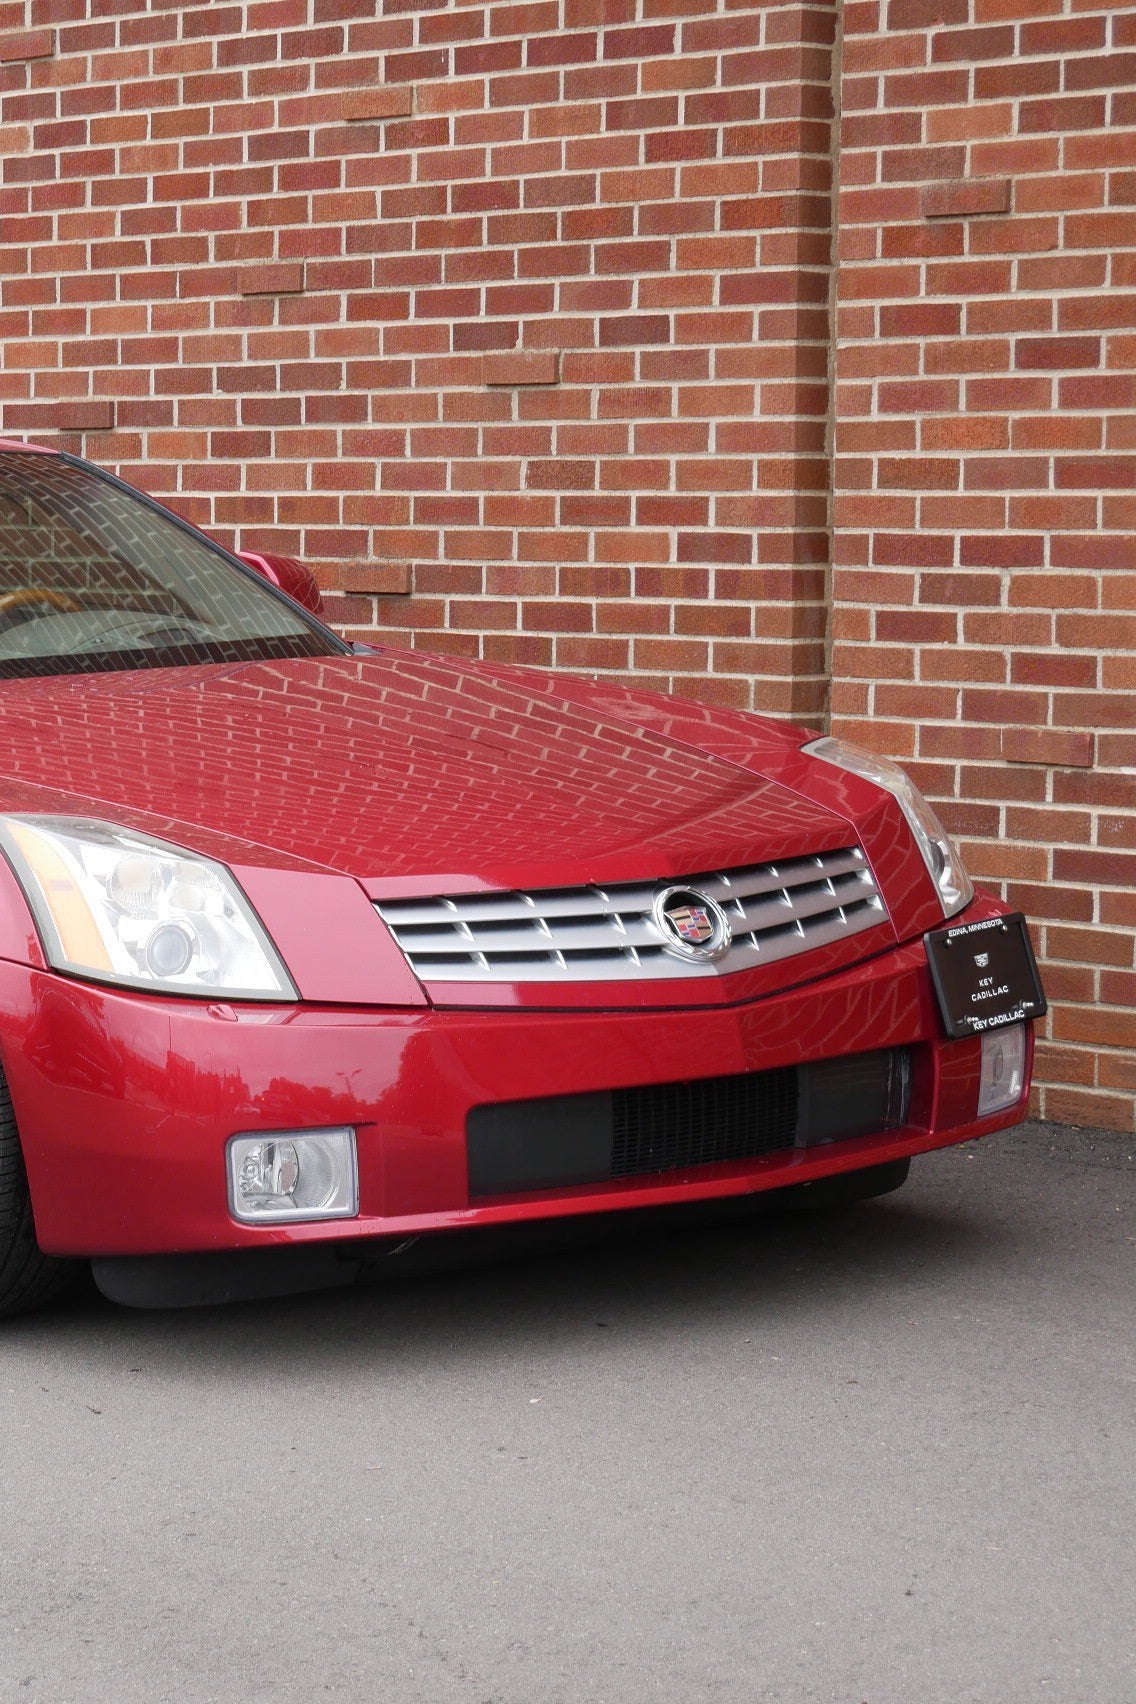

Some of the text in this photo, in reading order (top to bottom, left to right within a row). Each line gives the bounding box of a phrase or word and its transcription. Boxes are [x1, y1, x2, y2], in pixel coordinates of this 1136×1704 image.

[948, 918, 1003, 938] EDINA, MINNESOTA
[978, 977, 993, 987] KEY
[971, 985, 1009, 1001] CADILLAC
[973, 1010, 1025, 1030] KEY CADILLAC
